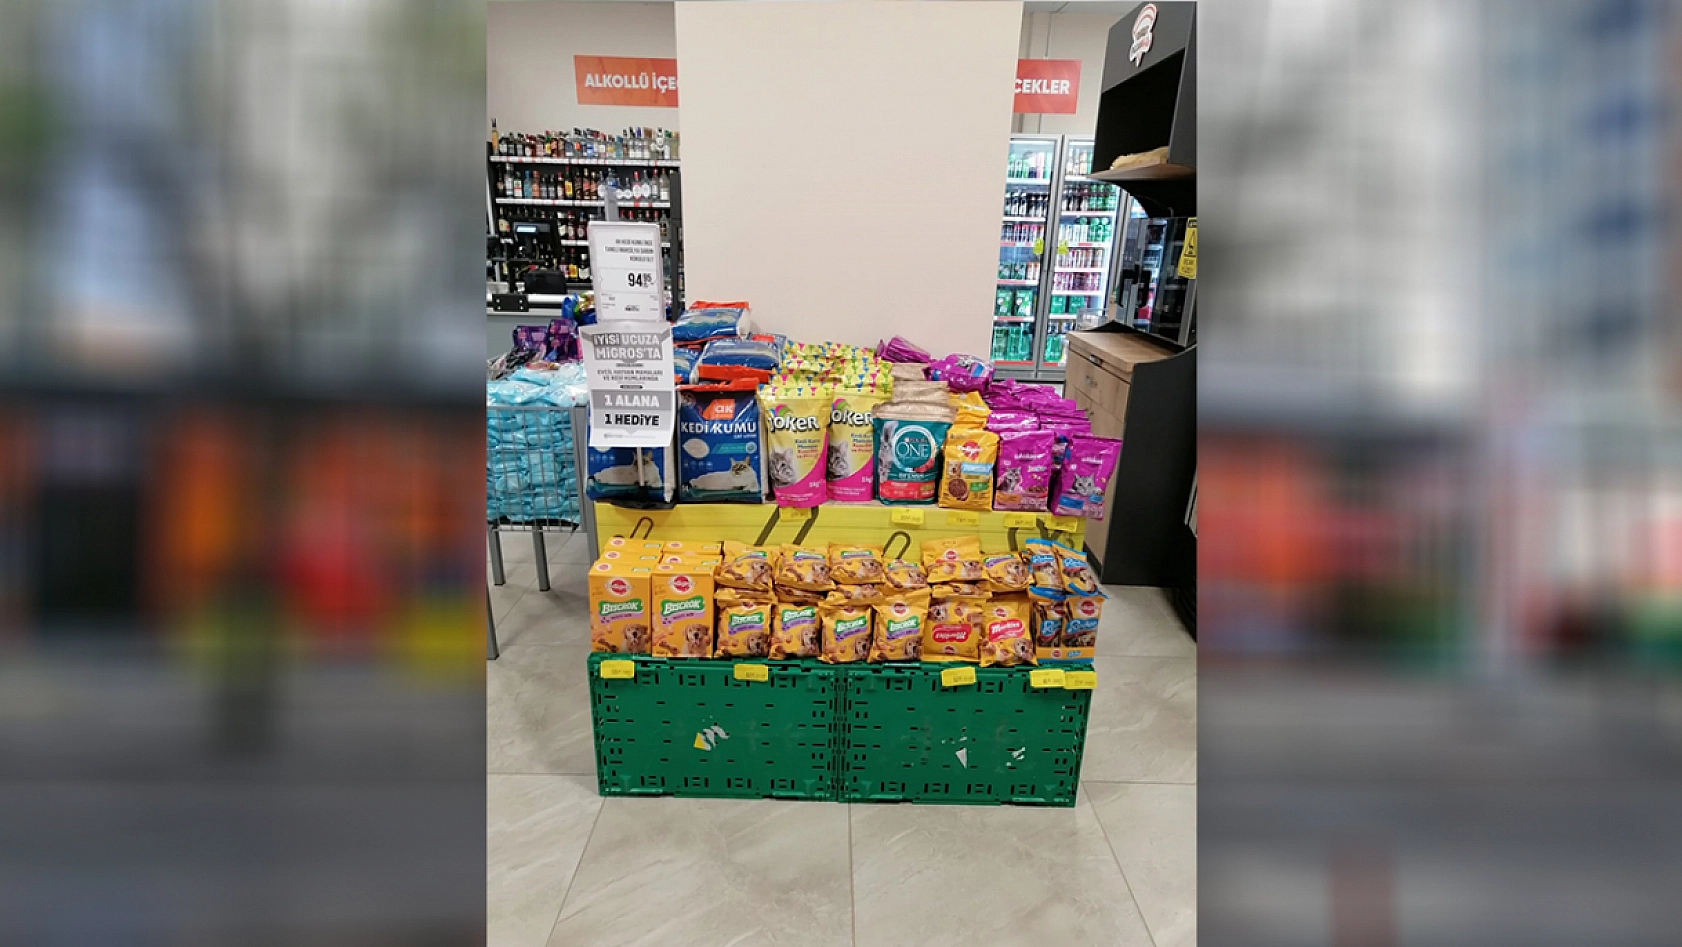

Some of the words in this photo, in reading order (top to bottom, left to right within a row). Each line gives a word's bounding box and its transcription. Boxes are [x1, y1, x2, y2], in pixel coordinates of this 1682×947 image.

[584, 72, 649, 89] ALKOLLÜ
[651, 72, 677, 94] İÇE
[628, 272, 642, 287] 94
[620, 333, 660, 346] UCUZA
[604, 394, 613, 406] 1
[615, 394, 660, 407] ALANA
[604, 413, 613, 425] 1
[615, 414, 660, 426] HEDİYE
[897, 441, 929, 458] ONE
